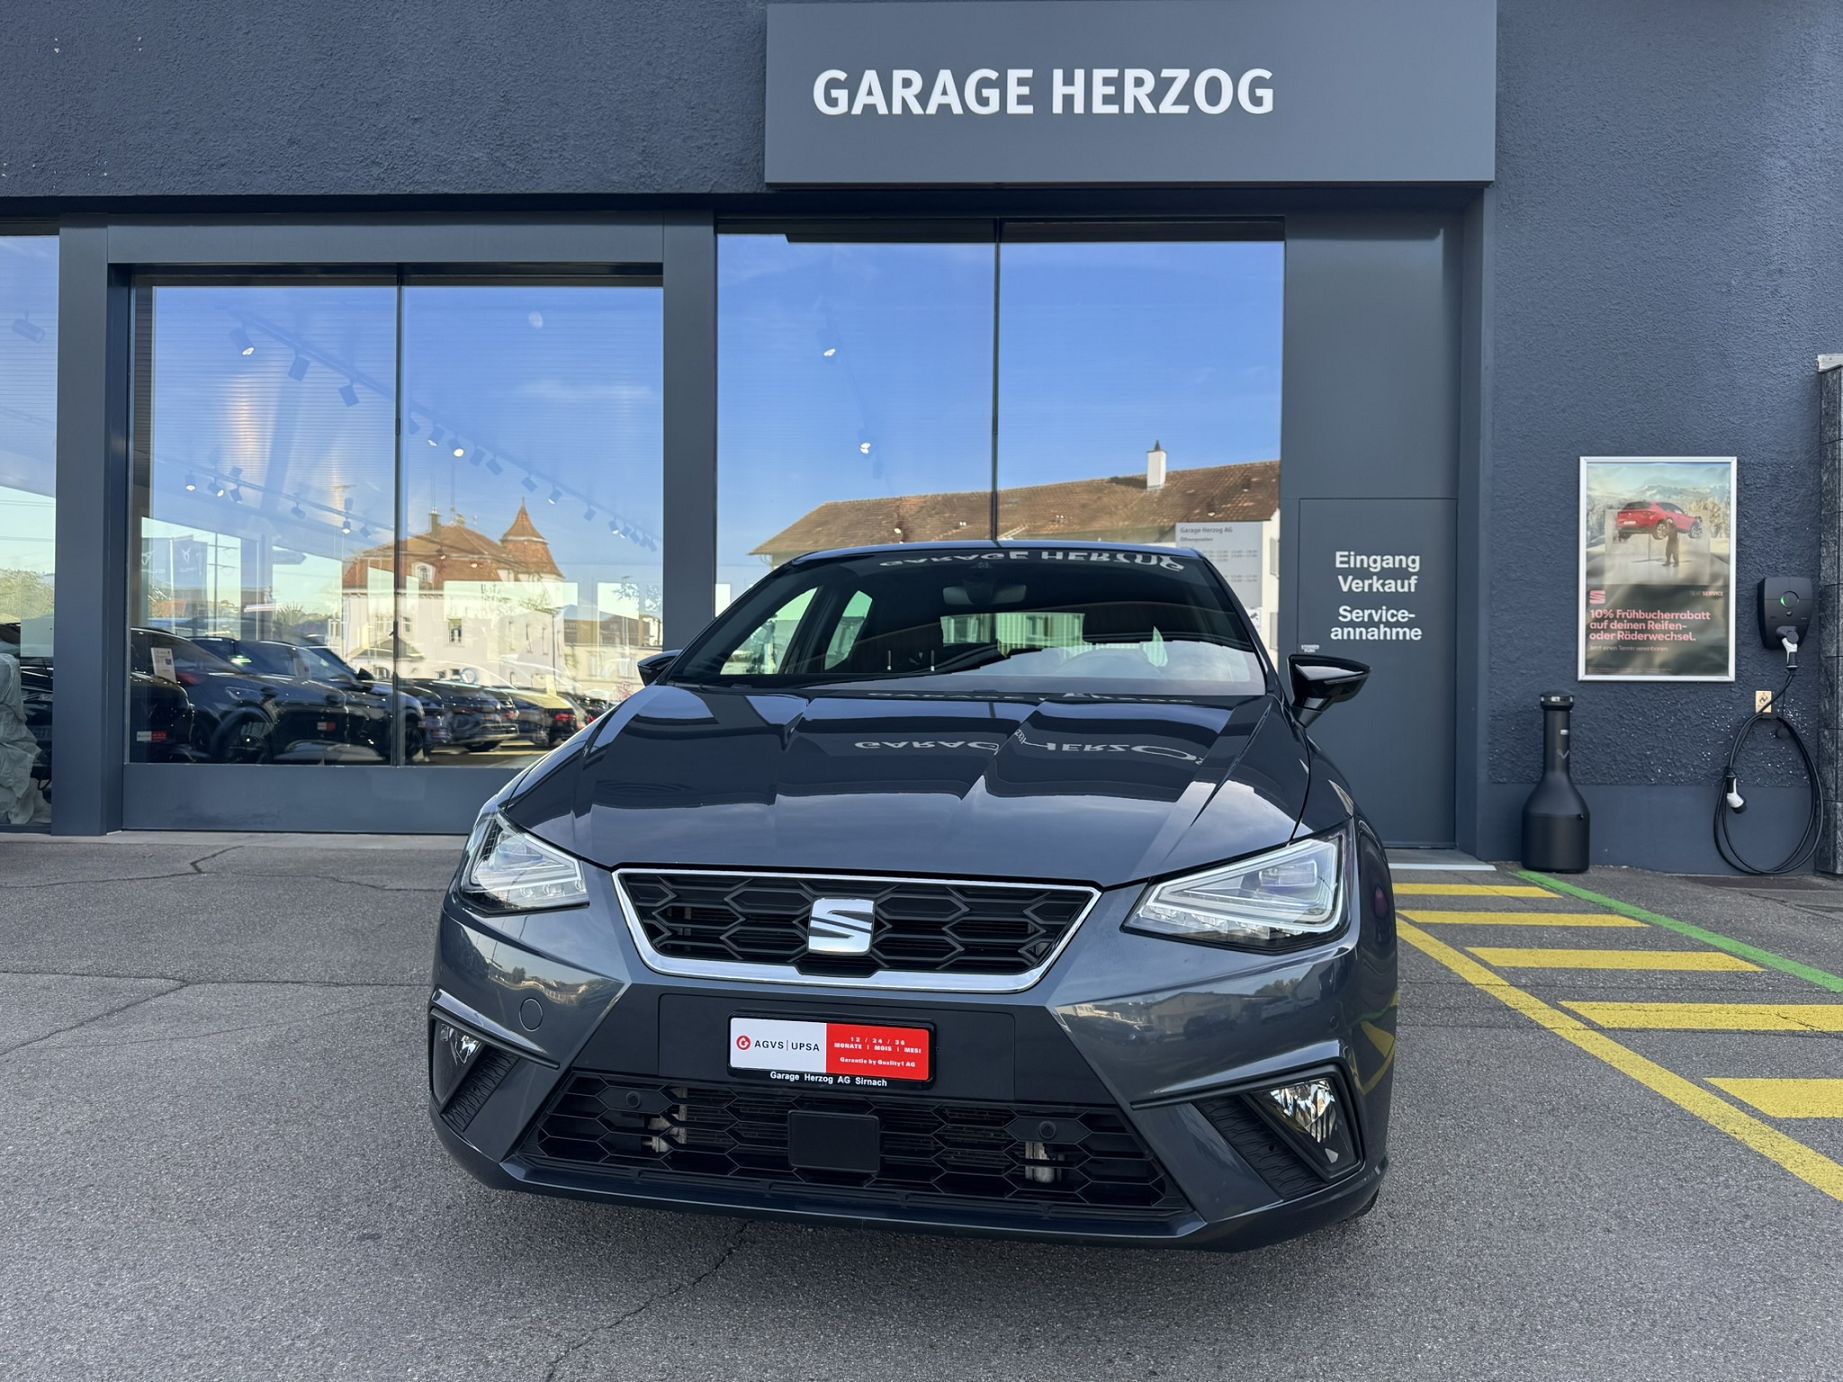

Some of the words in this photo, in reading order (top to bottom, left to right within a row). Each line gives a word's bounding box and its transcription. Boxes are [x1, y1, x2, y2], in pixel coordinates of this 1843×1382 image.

[812, 68, 1034, 115] GARAGE
[1051, 68, 1275, 115] HERZOG
[1335, 551, 1420, 572] Eingang
[1337, 575, 1419, 592] Verkauf
[1338, 605, 1416, 622] Service-
[1590, 609, 1614, 619] 10%
[1616, 609, 1711, 620] Frühbucherrabatt
[1330, 624, 1422, 640] annahme
[1589, 620, 1608, 629] auf
[1610, 620, 1646, 630] deinen
[1647, 620, 1687, 631] Reifen-
[1589, 631, 1616, 640] oder
[1617, 630, 1697, 641] Räderwechsel.
[754, 1039, 784, 1050] AGVS
[791, 1042, 820, 1052] UPSA
[770, 1071, 799, 1082] Garage
[804, 1074, 834, 1084] Herzog
[837, 1076, 851, 1084] AG
[855, 1077, 888, 1087] Sirnach
